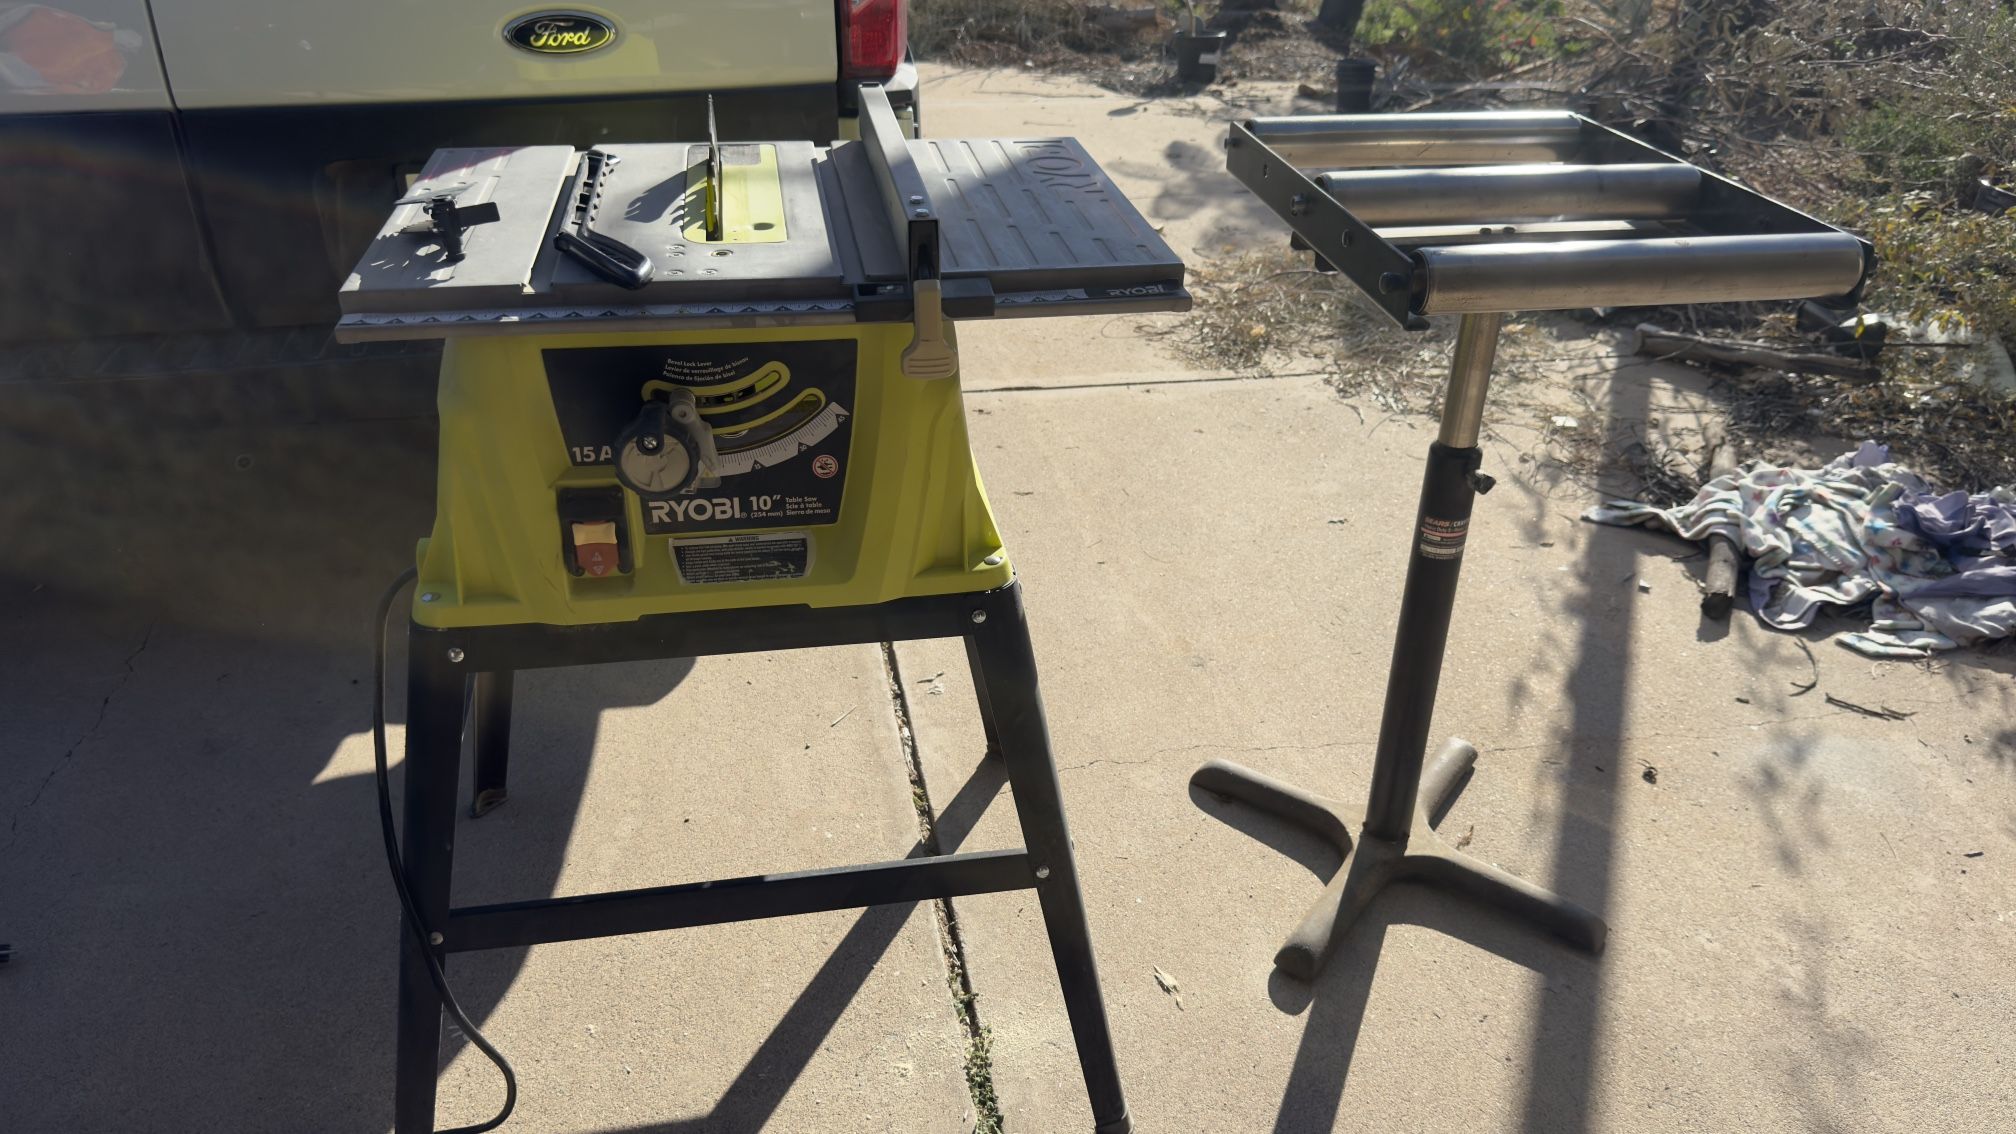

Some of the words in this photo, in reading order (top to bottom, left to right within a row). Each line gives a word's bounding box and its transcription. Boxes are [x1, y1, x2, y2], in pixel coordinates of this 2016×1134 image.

[530, 20, 591, 47] Ford
[1106, 284, 1165, 296] RYOBI
[667, 358, 682, 366] Bevel
[572, 446, 596, 463] 15
